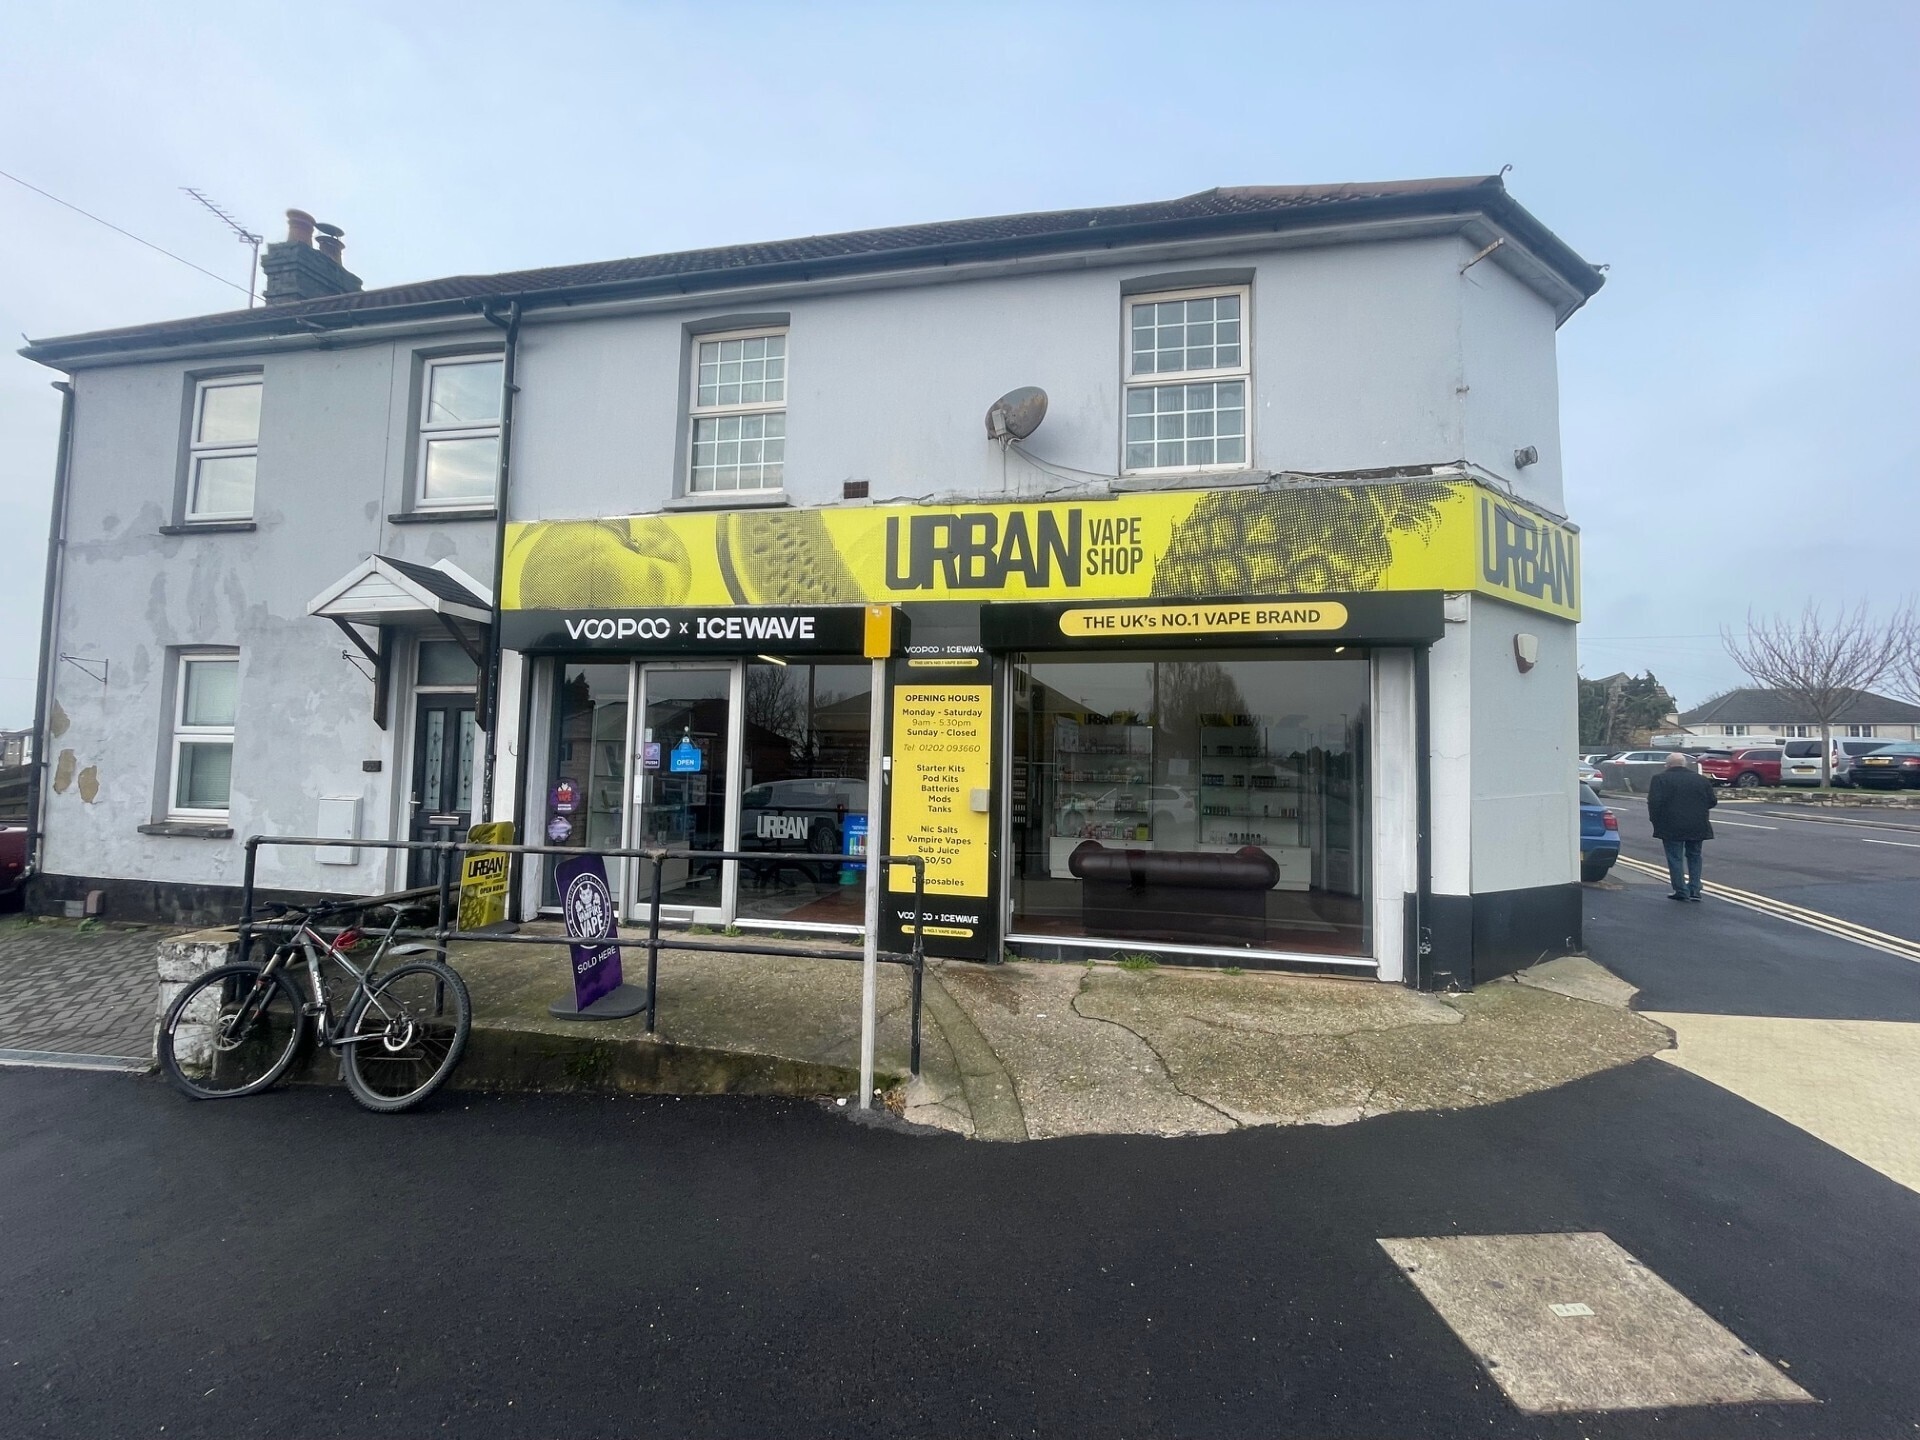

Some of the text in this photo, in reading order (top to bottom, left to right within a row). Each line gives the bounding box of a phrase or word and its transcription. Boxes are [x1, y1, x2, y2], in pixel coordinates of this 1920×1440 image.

[1088, 516, 1142, 546] VAPE
[885, 508, 1082, 591] URBAN
[1481, 497, 1575, 610] URBAN
[1086, 546, 1144, 576] SHOP
[1083, 609, 1321, 629] THE UK's NO.1 VAPE BRAND
[564, 618, 671, 640] VOOPOO
[696, 616, 815, 639] ICEWAVE
[904, 645, 940, 654] VOOPOO
[946, 645, 984, 653] ICEWAVE
[905, 694, 980, 702] OPENING HOURS
[902, 708, 935, 717] Monday
[943, 708, 982, 717] Saturday
[912, 718, 931, 727] 9am
[907, 728, 938, 737] Sunday
[946, 728, 977, 737] Closed
[918, 744, 945, 752] 01202
[946, 744, 981, 752] 093660
[916, 764, 966, 773] Starter Kits
[942, 775, 959, 783] Kits
[921, 784, 960, 793] Batteries
[928, 795, 952, 803] Mods
[928, 805, 952, 813] Tanks
[756, 815, 809, 840] URBAN
[920, 825, 958, 834] Nic Salts
[907, 835, 971, 846] Vampire Vapes
[918, 845, 960, 855] Sub Juice
[925, 856, 952, 865] 50/50
[468, 855, 504, 878] URBAN
[479, 883, 505, 895] OPEN NOW
[897, 910, 933, 921] VOOOO
[940, 913, 979, 924] ICEWAVE
[580, 914, 606, 939] VAPE
[577, 945, 617, 974] SOLD HERE
